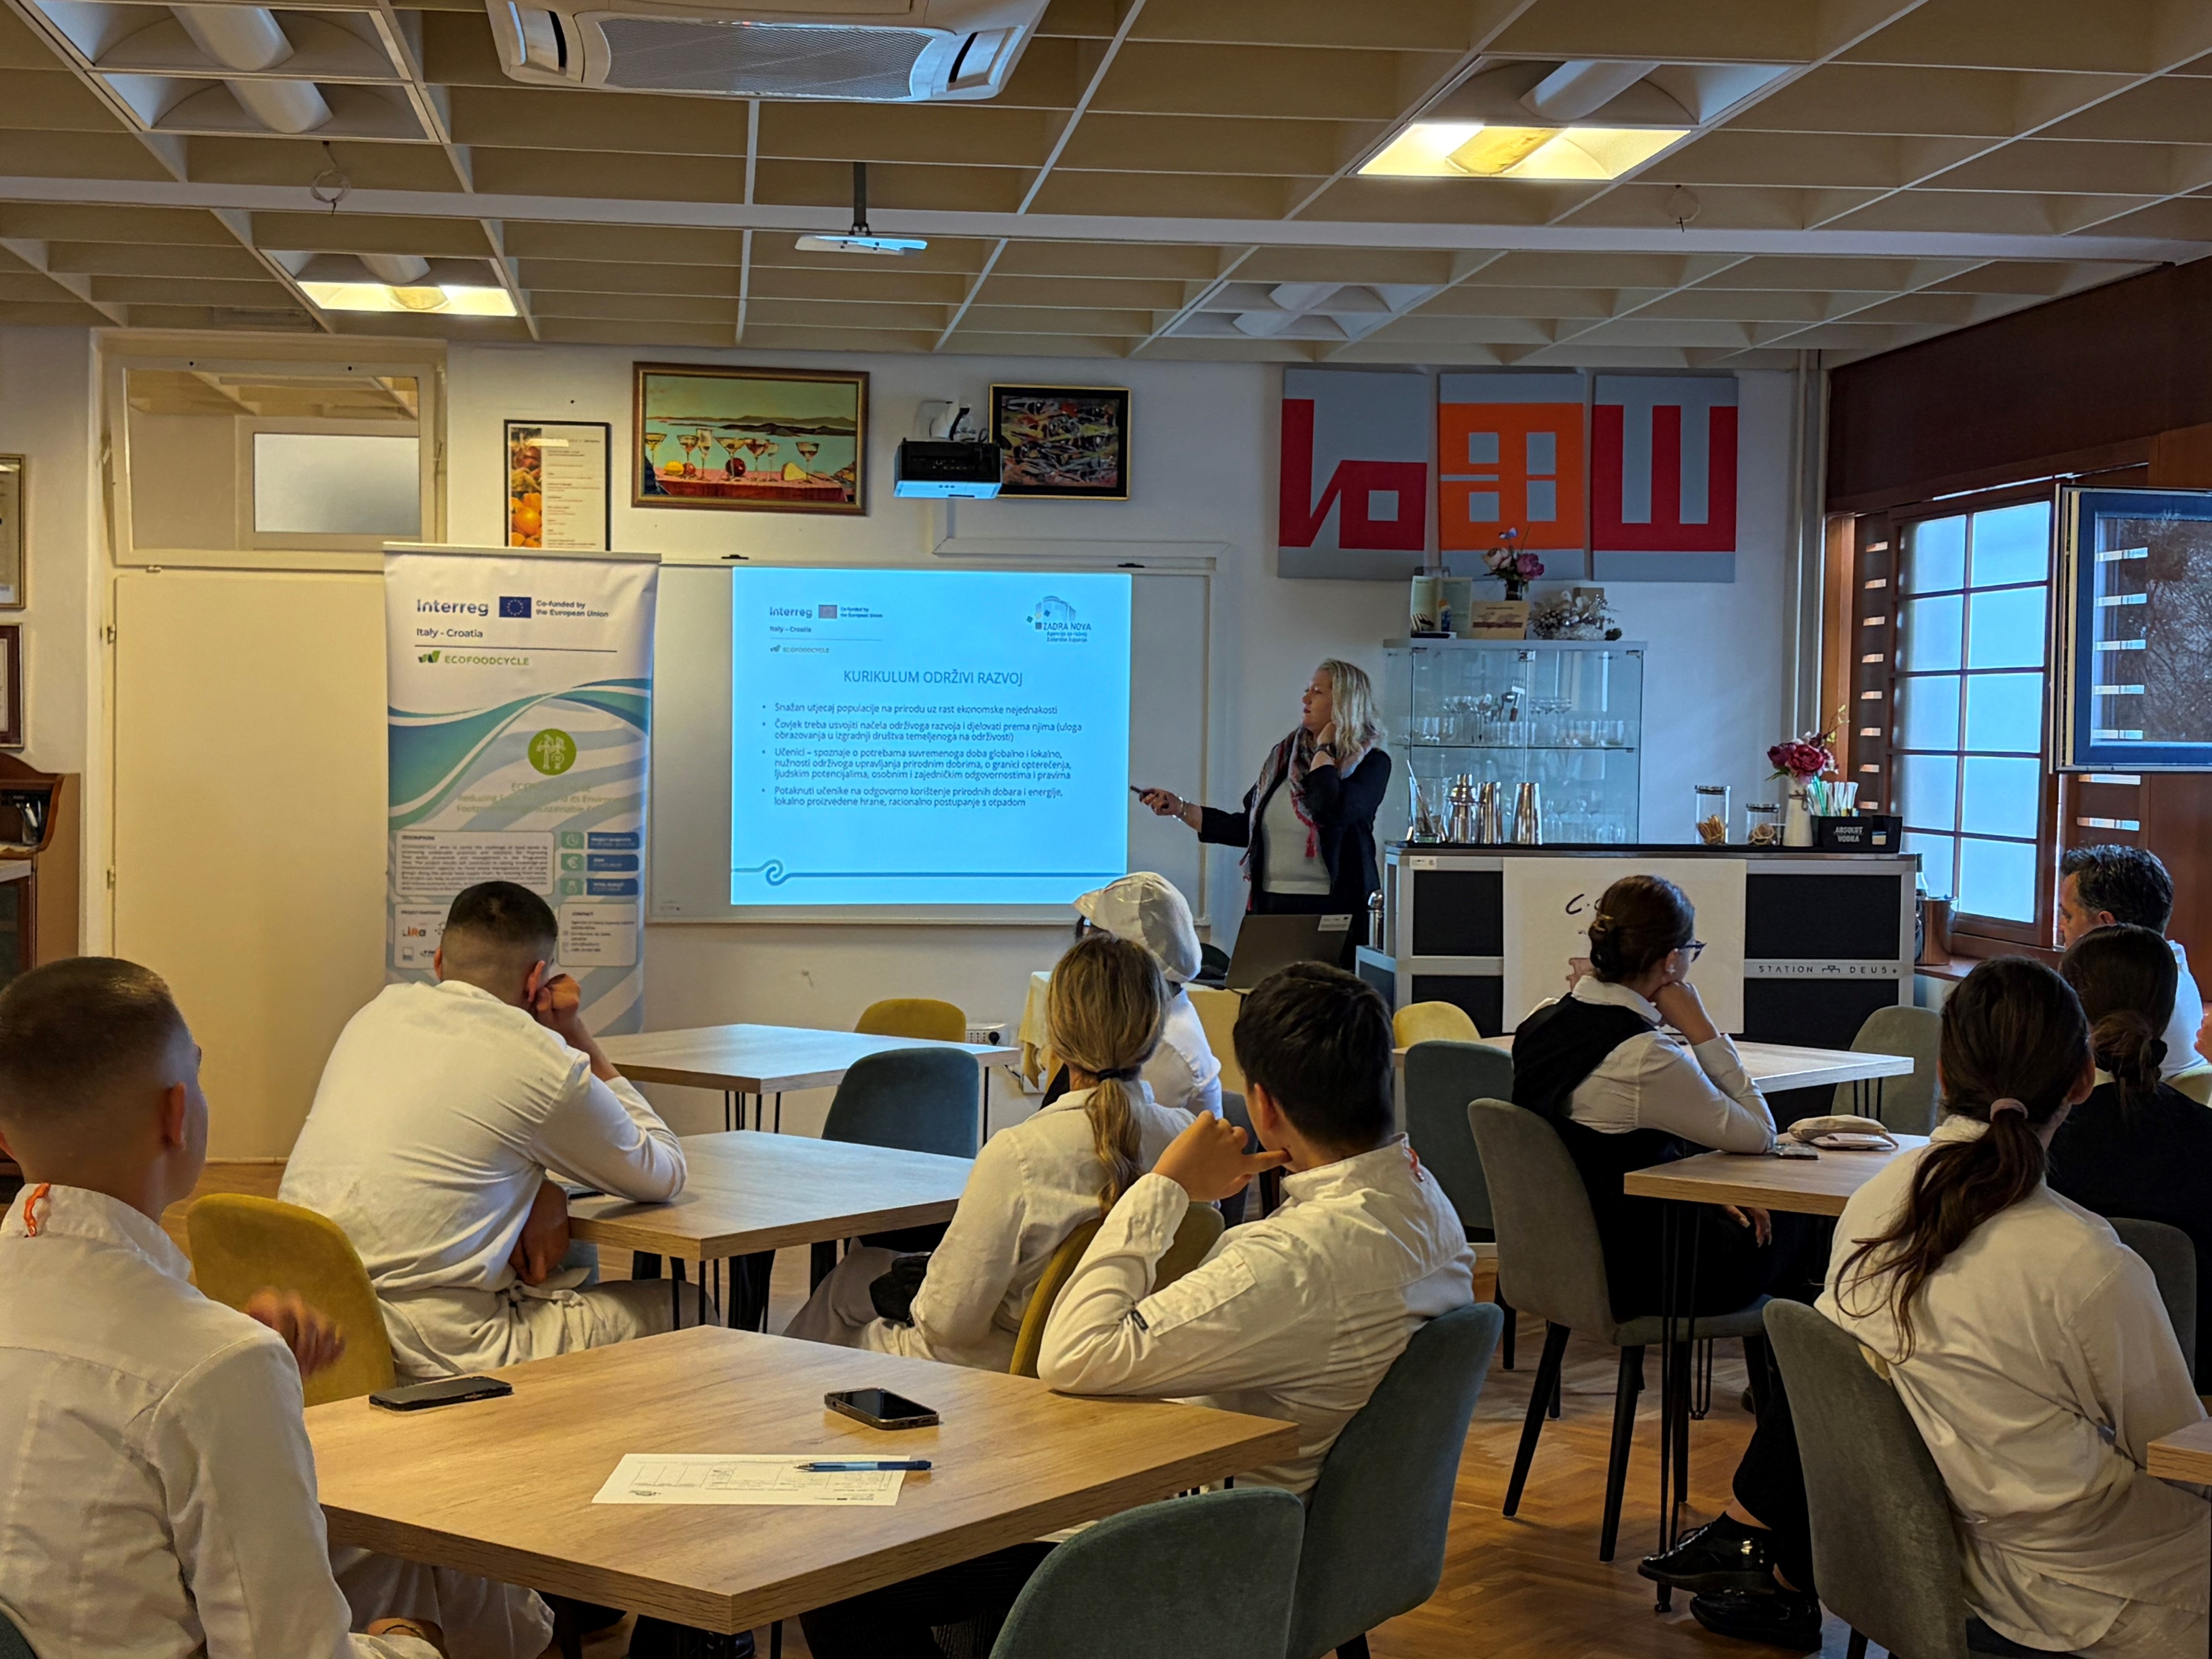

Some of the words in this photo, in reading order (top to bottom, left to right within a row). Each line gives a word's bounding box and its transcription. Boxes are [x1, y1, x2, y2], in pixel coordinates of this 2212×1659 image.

[417, 599, 489, 617] Interreg
[549, 609, 585, 617] European
[769, 607, 812, 619] Interreg
[1043, 622, 1068, 630] ZADRA
[417, 628, 439, 639] Italy
[446, 629, 483, 638] Croatia
[444, 655, 529, 665] ECOFOODCYCLE
[844, 670, 919, 683] KURIKULUM
[923, 669, 974, 684] ODRŽIVI
[977, 672, 1023, 687] RAZVOJ
[775, 702, 805, 712] Snažan
[807, 703, 835, 714] utjecaj
[837, 703, 879, 715] populacije
[894, 704, 925, 715] prirodu
[957, 705, 1004, 714] ekonomske
[1006, 705, 1057, 716] nejednakosti
[775, 719, 802, 732] Čovjek
[804, 720, 826, 729] treba
[829, 721, 858, 732] usvojiti
[860, 721, 887, 729] načela
[889, 721, 929, 733] održivoga
[931, 721, 961, 733] razvoja
[967, 721, 1001, 733] djelovati
[1003, 724, 1030, 733] prema
[1032, 722, 1055, 733] njima
[775, 730, 826, 742] obrazovanja
[835, 730, 871, 742] izgradnji
[872, 731, 904, 740] društva
[906, 730, 957, 743] temeljenoga
[775, 747, 805, 756] Učenici
[814, 749, 850, 759] spoznaje
[860, 749, 906, 759] potrebama
[908, 750, 964, 760] suvremenoga
[966, 749, 987, 758] doba
[989, 749, 1025, 760] globalno
[775, 758, 810, 767] nužnosti
[812, 758, 853, 770] održivoga
[855, 758, 901, 770] upravljanja
[903, 759, 944, 771] prirodnim
[992, 759, 1020, 771] granici
[774, 769, 809, 780] ljudskim
[871, 769, 908, 778] osobnim
[914, 769, 962, 781] zajedničkim
[965, 769, 1031, 781] odgovornostima
[1037, 769, 1071, 781] pravima
[774, 786, 814, 795] Potaknuti
[816, 786, 848, 795] učenike
[863, 787, 908, 798] odgovorno
[910, 787, 951, 798] korištenje
[953, 787, 991, 798] prirodnih
[993, 787, 1022, 796] dobara
[774, 797, 805, 805] lokalno
[807, 797, 858, 807] proizvedene
[889, 797, 932, 806] racionalno
[934, 796, 980, 809] postupanje
[988, 798, 1026, 809] otpadom
